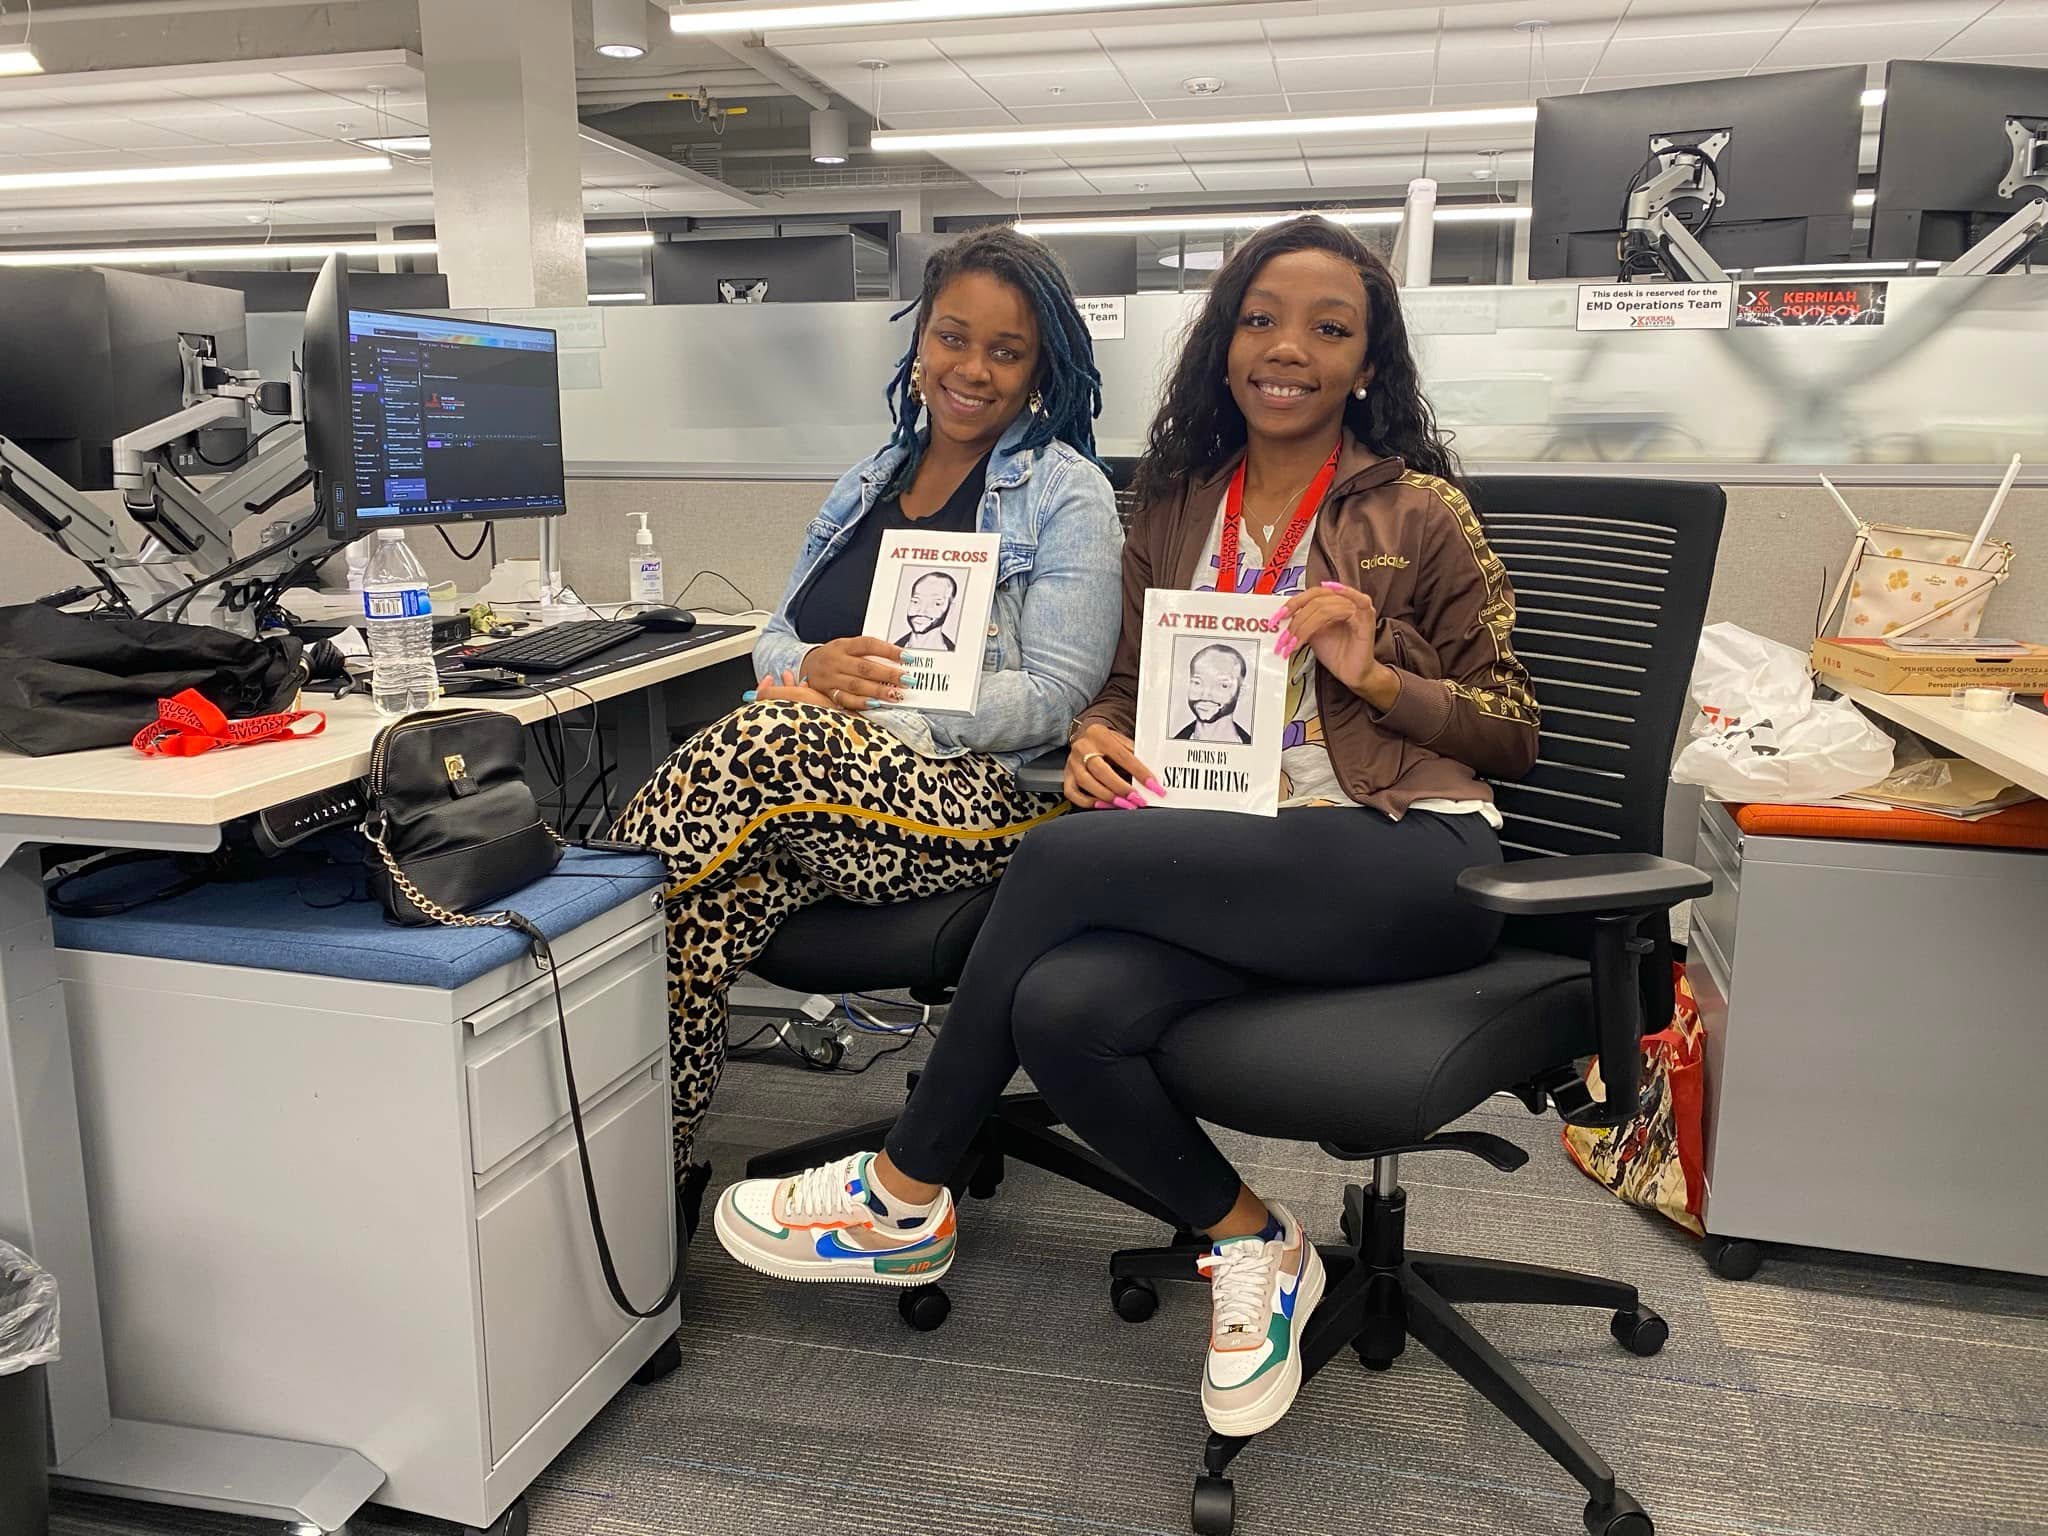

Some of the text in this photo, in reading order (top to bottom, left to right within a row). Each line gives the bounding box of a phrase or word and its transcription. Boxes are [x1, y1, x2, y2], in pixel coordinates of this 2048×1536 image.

[1592, 288, 1718, 298] This desk is reserved for the
[1783, 291, 1857, 304] KERMIAH
[1087, 302, 1100, 310] for
[1586, 300, 1722, 312] EMD Operations Team
[1782, 304, 1860, 317] JOHNSON
[1089, 312, 1118, 321] Team
[1276, 518, 1304, 554] KRUCIAL
[890, 547, 988, 563] AT THE CROSS
[1227, 532, 1238, 574] KRUCIAL
[1360, 553, 1399, 570] adida
[1158, 612, 1181, 628] AT
[1183, 613, 1219, 630] THE
[924, 656, 936, 668] BY
[1187, 749, 1229, 765] POEMS BY
[1163, 766, 1249, 793] SETH IRVING
[321, 808, 330, 817] 2
[331, 805, 338, 814] 3
[906, 1261, 931, 1273] AIR
